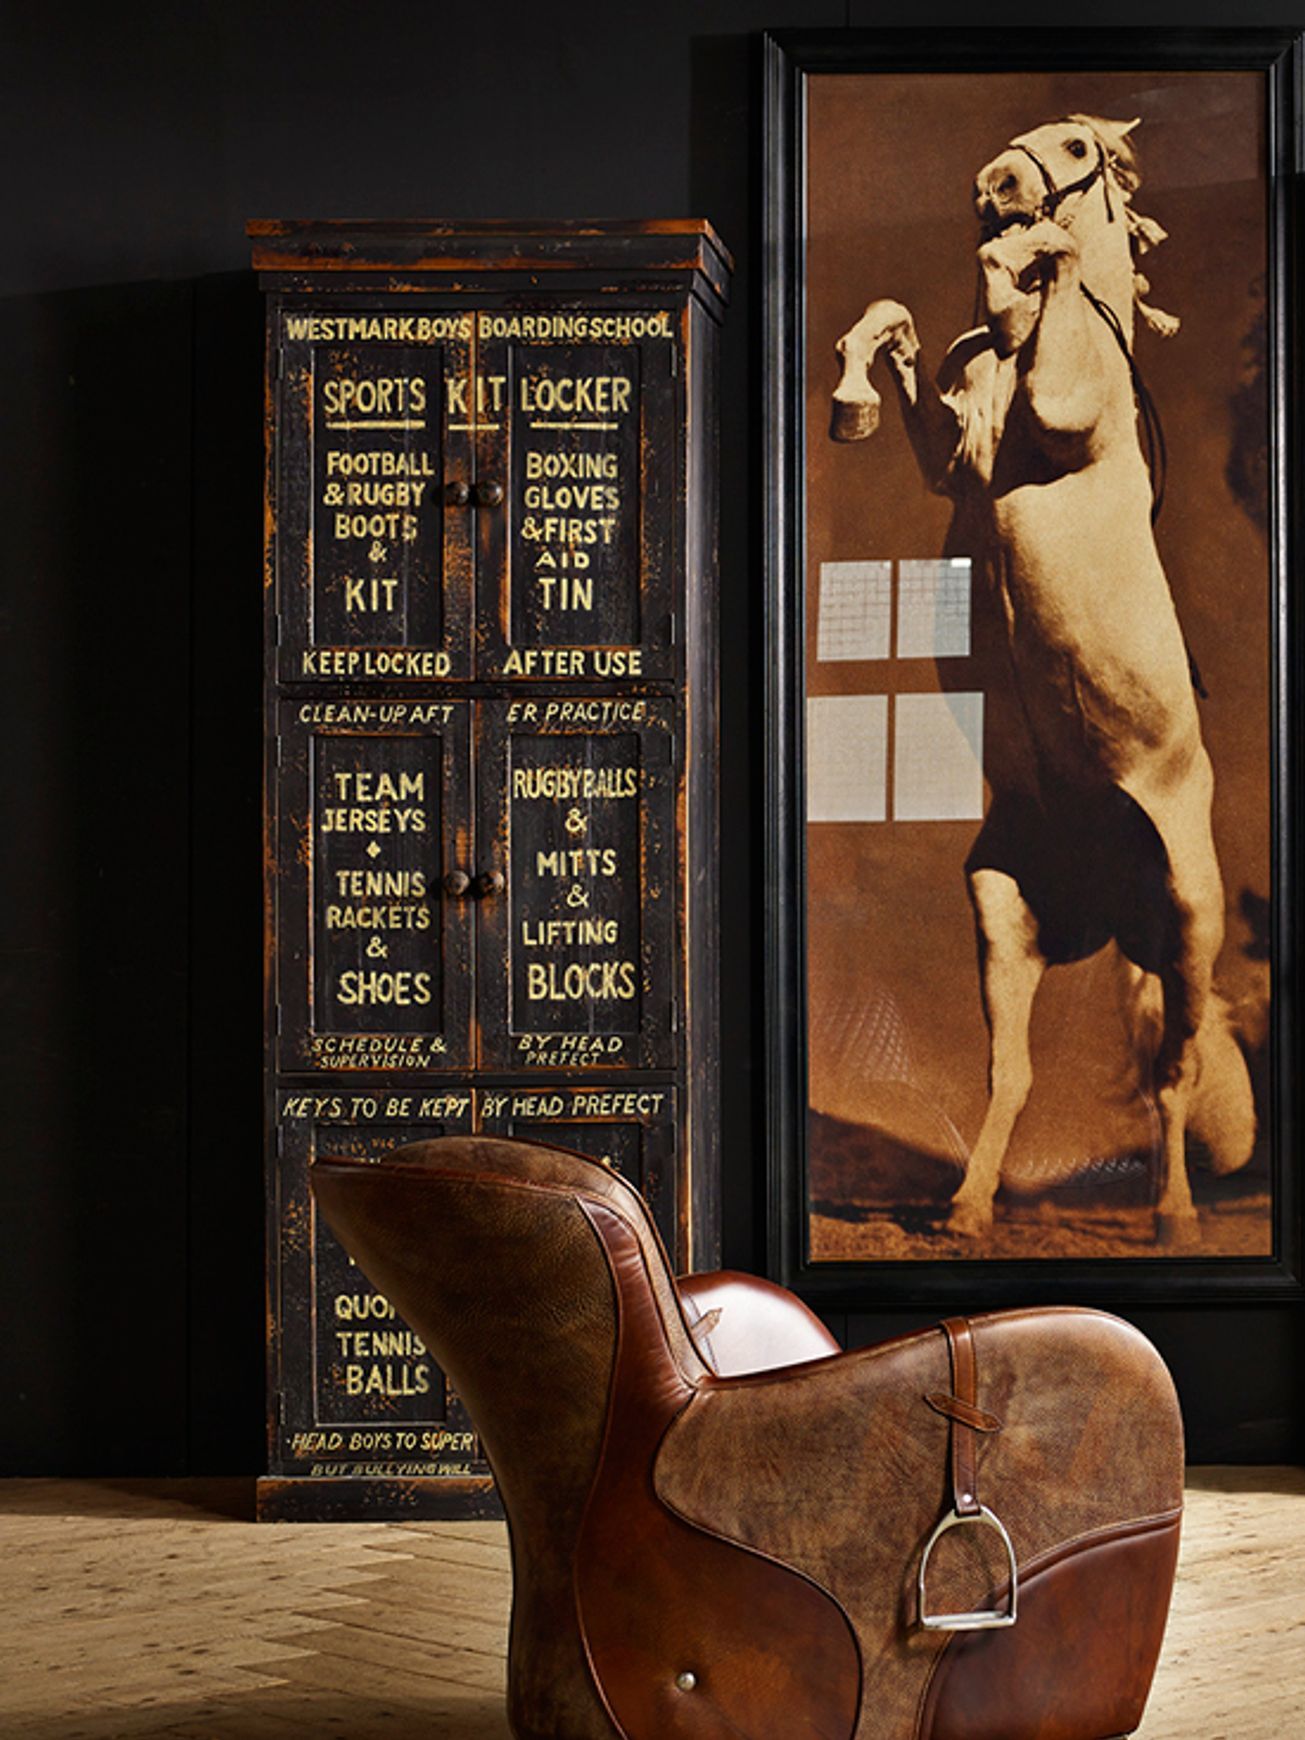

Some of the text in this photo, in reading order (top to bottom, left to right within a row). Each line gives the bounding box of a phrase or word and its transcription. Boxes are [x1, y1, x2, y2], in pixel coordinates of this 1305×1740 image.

[324, 377, 426, 414] SPORTS
[521, 377, 631, 412] LOCKER
[327, 452, 435, 476] FOOTBALL
[527, 453, 618, 479] BOXING
[524, 486, 620, 510] GLOVES
[335, 513, 418, 540] BOOTS
[369, 542, 387, 562] &
[535, 551, 590, 569] AID
[345, 579, 398, 612] KIT
[538, 577, 593, 611] TIN
[503, 650, 642, 676] AFTER USE
[546, 701, 646, 722] PRACTICE
[334, 772, 425, 802] TEAM
[321, 808, 427, 833] JERSEYS
[564, 809, 588, 833] &
[537, 850, 617, 877] MITTS
[336, 870, 427, 897] TENNIS
[567, 885, 590, 908] &
[326, 905, 431, 930] RACKETS
[522, 921, 618, 946] LIFTING
[366, 937, 388, 958] &
[337, 972, 431, 1006] SHOES
[528, 963, 636, 1001] BLOCKS
[312, 1037, 448, 1053] SCHEDULE &
[518, 1036, 623, 1053] BY HEAD
[320, 1055, 430, 1069] SUPERVISION
[525, 1052, 601, 1066] PREFECT
[283, 1094, 664, 1118] KEYS TO BE KEPT BY HEAD PREFECT
[335, 1331, 427, 1357] TENNIS
[346, 1364, 430, 1396] BALLS
[291, 1432, 474, 1451] HEAD BOYS TO SUPER
[311, 1463, 347, 1476] BUT
